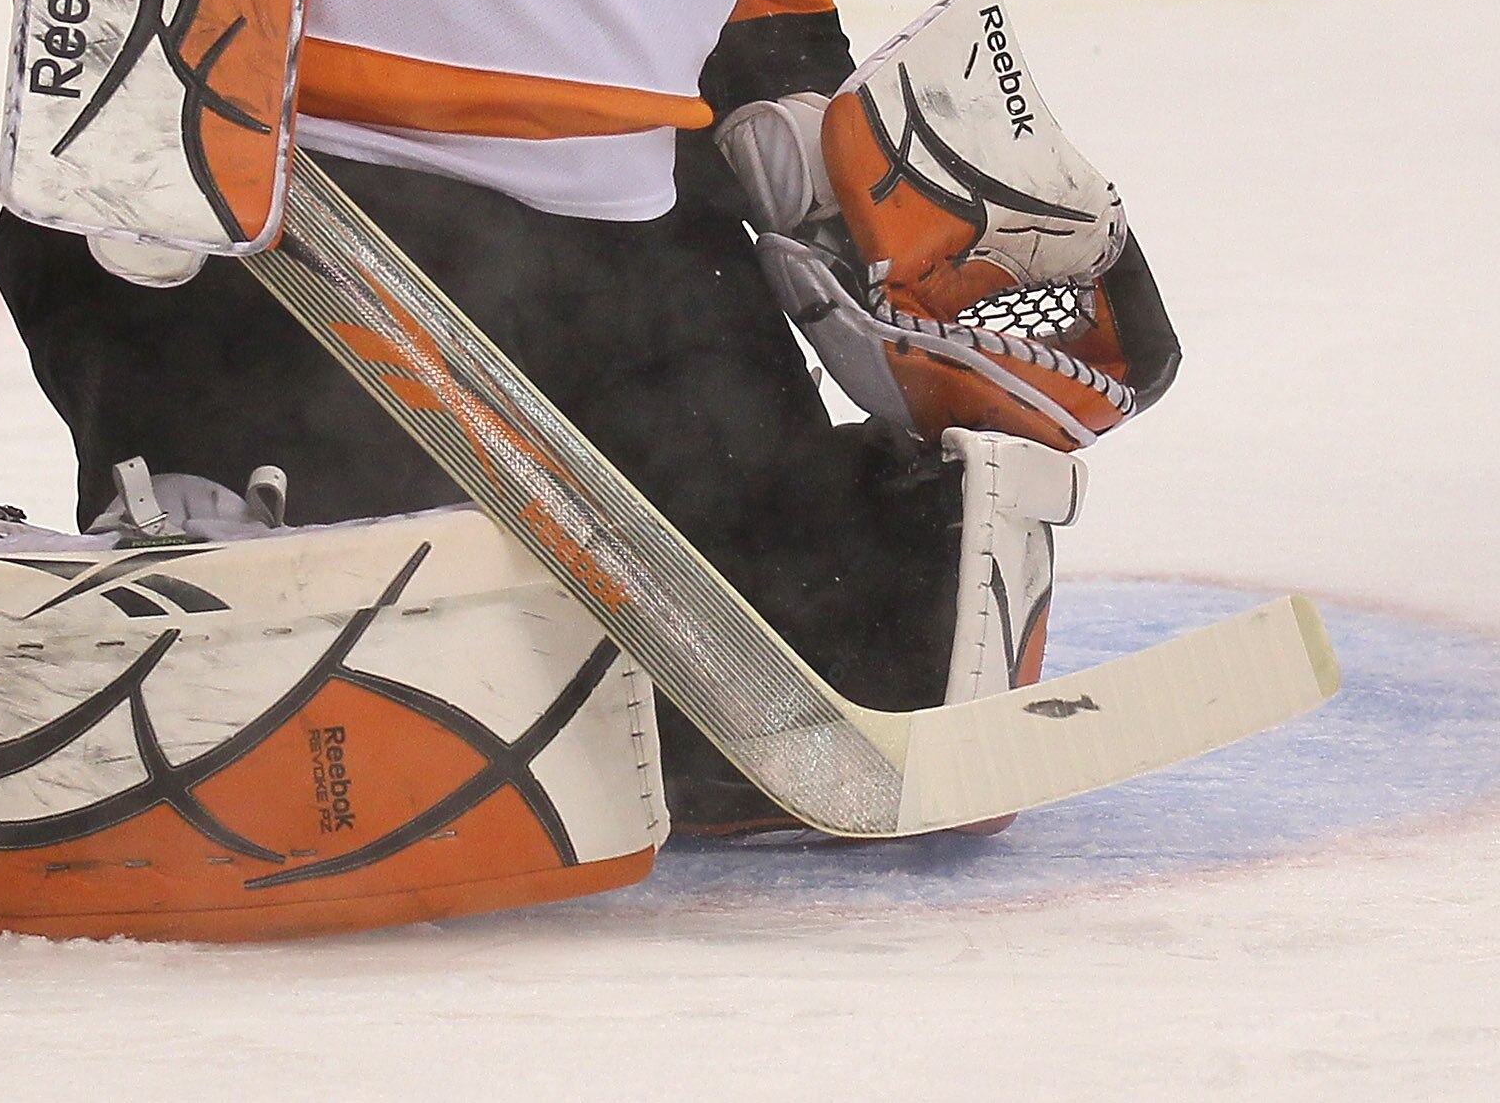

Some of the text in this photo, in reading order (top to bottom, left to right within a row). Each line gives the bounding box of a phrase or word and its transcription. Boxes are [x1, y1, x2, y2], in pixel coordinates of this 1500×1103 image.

[979, 5, 1035, 140] Reebok
[518, 498, 632, 615] Reebok
[322, 725, 356, 833] Reebok
